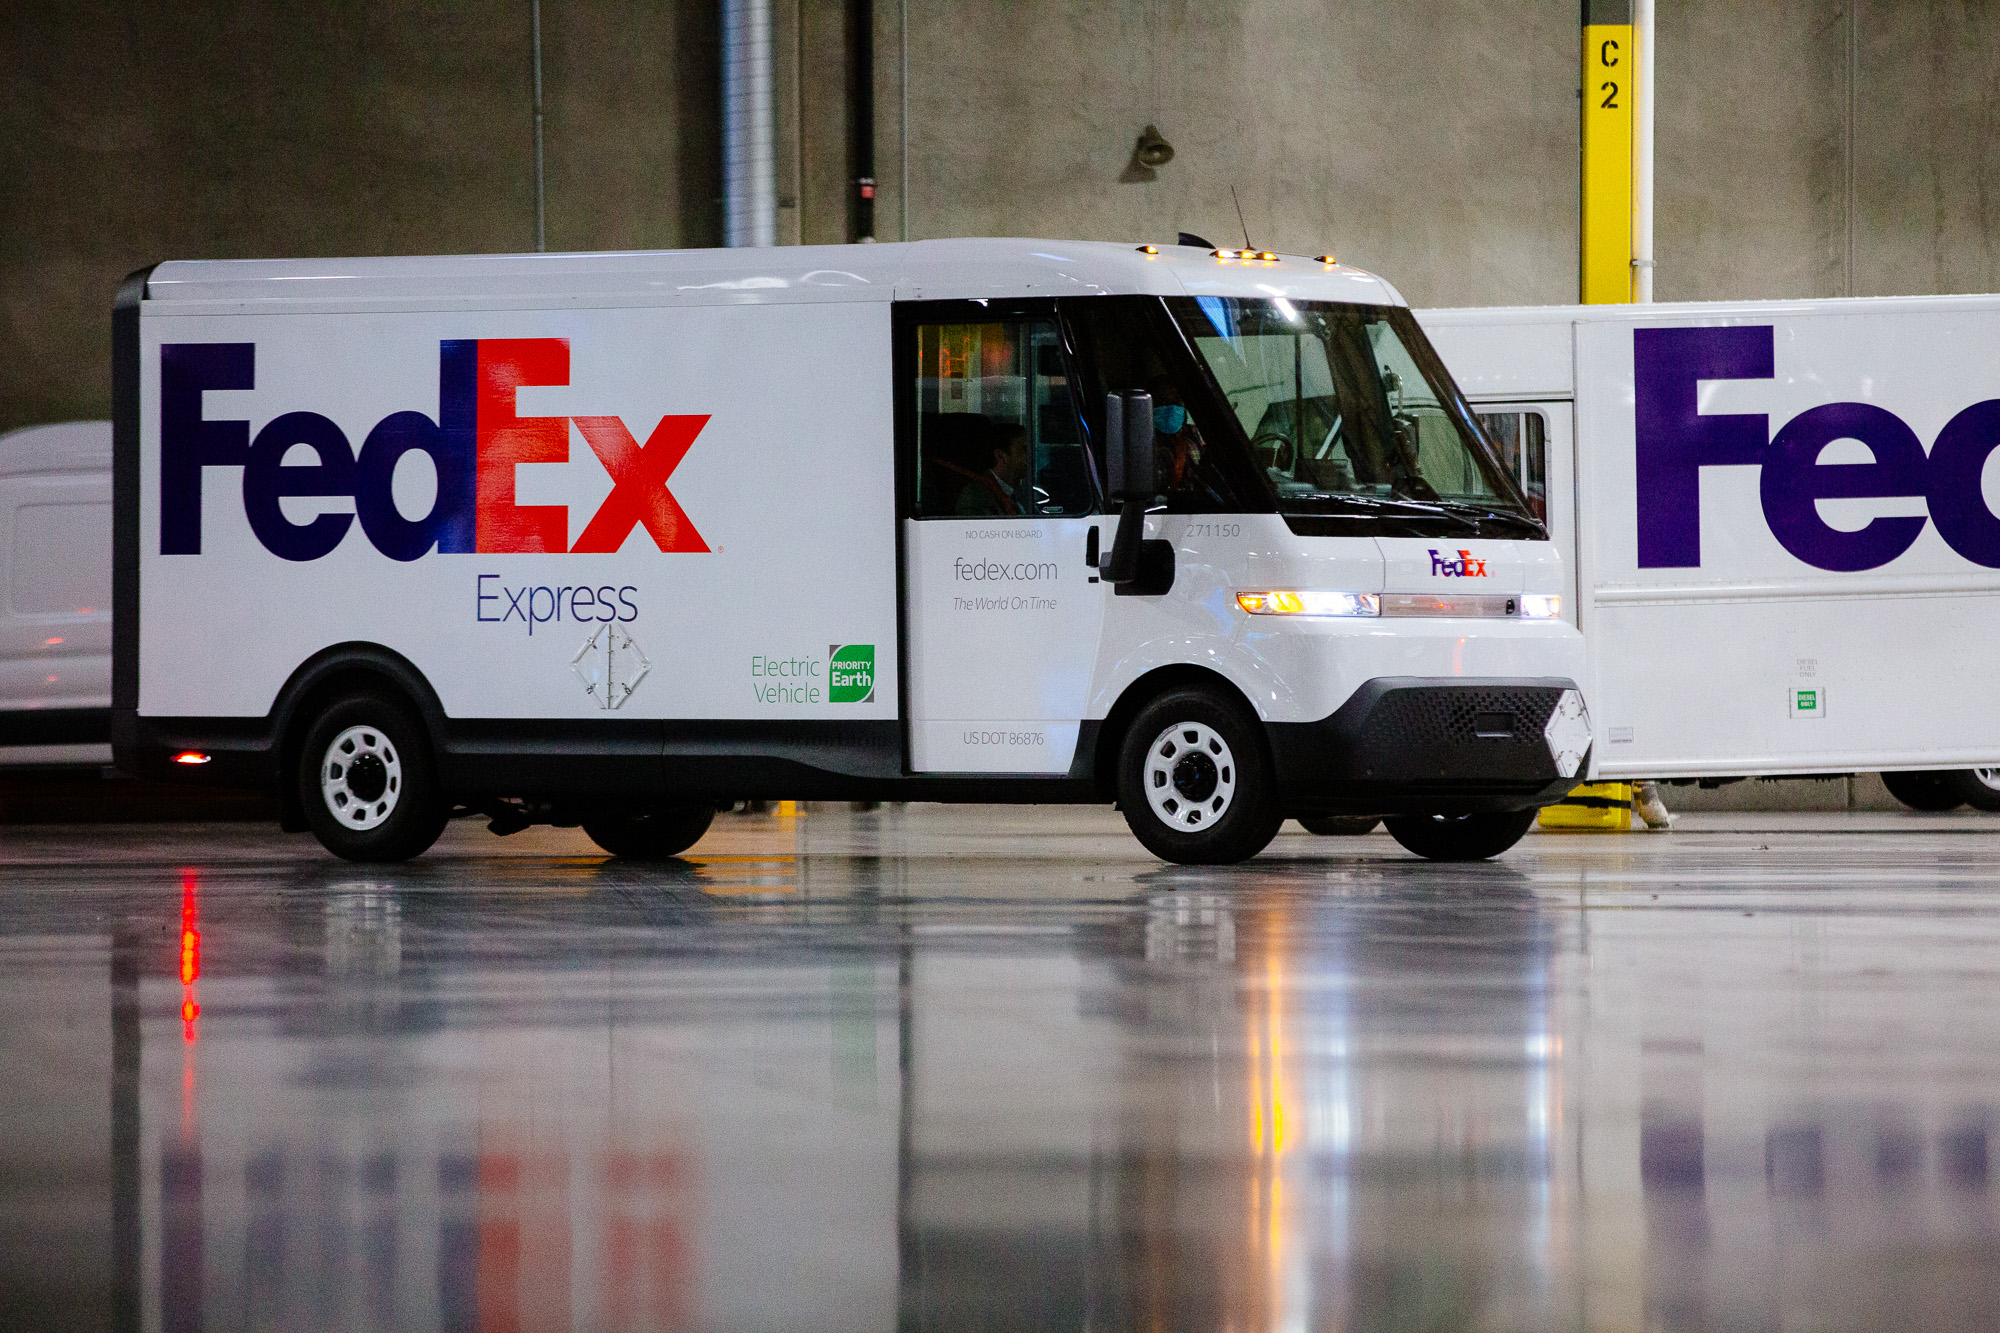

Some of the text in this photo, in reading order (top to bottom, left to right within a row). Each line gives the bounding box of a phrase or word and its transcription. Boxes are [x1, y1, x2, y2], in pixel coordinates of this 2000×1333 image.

[1601, 40, 1619, 67] C
[1601, 81, 1619, 109] 2
[159, 338, 713, 562] FedEx
[965, 529, 1043, 539] NO CASH ON BOARD
[1186, 524, 1240, 538] 271150
[953, 557, 1058, 580] fedex.com
[1427, 549, 1487, 577] FedEx
[476, 574, 639, 636] Express
[953, 596, 1058, 610] The World On Time
[752, 655, 820, 677] Electric
[832, 661, 872, 670] PRIORITY
[831, 671, 872, 687] Earth
[753, 682, 820, 703] Vehicle
[963, 731, 1044, 745] US DOT 86876
